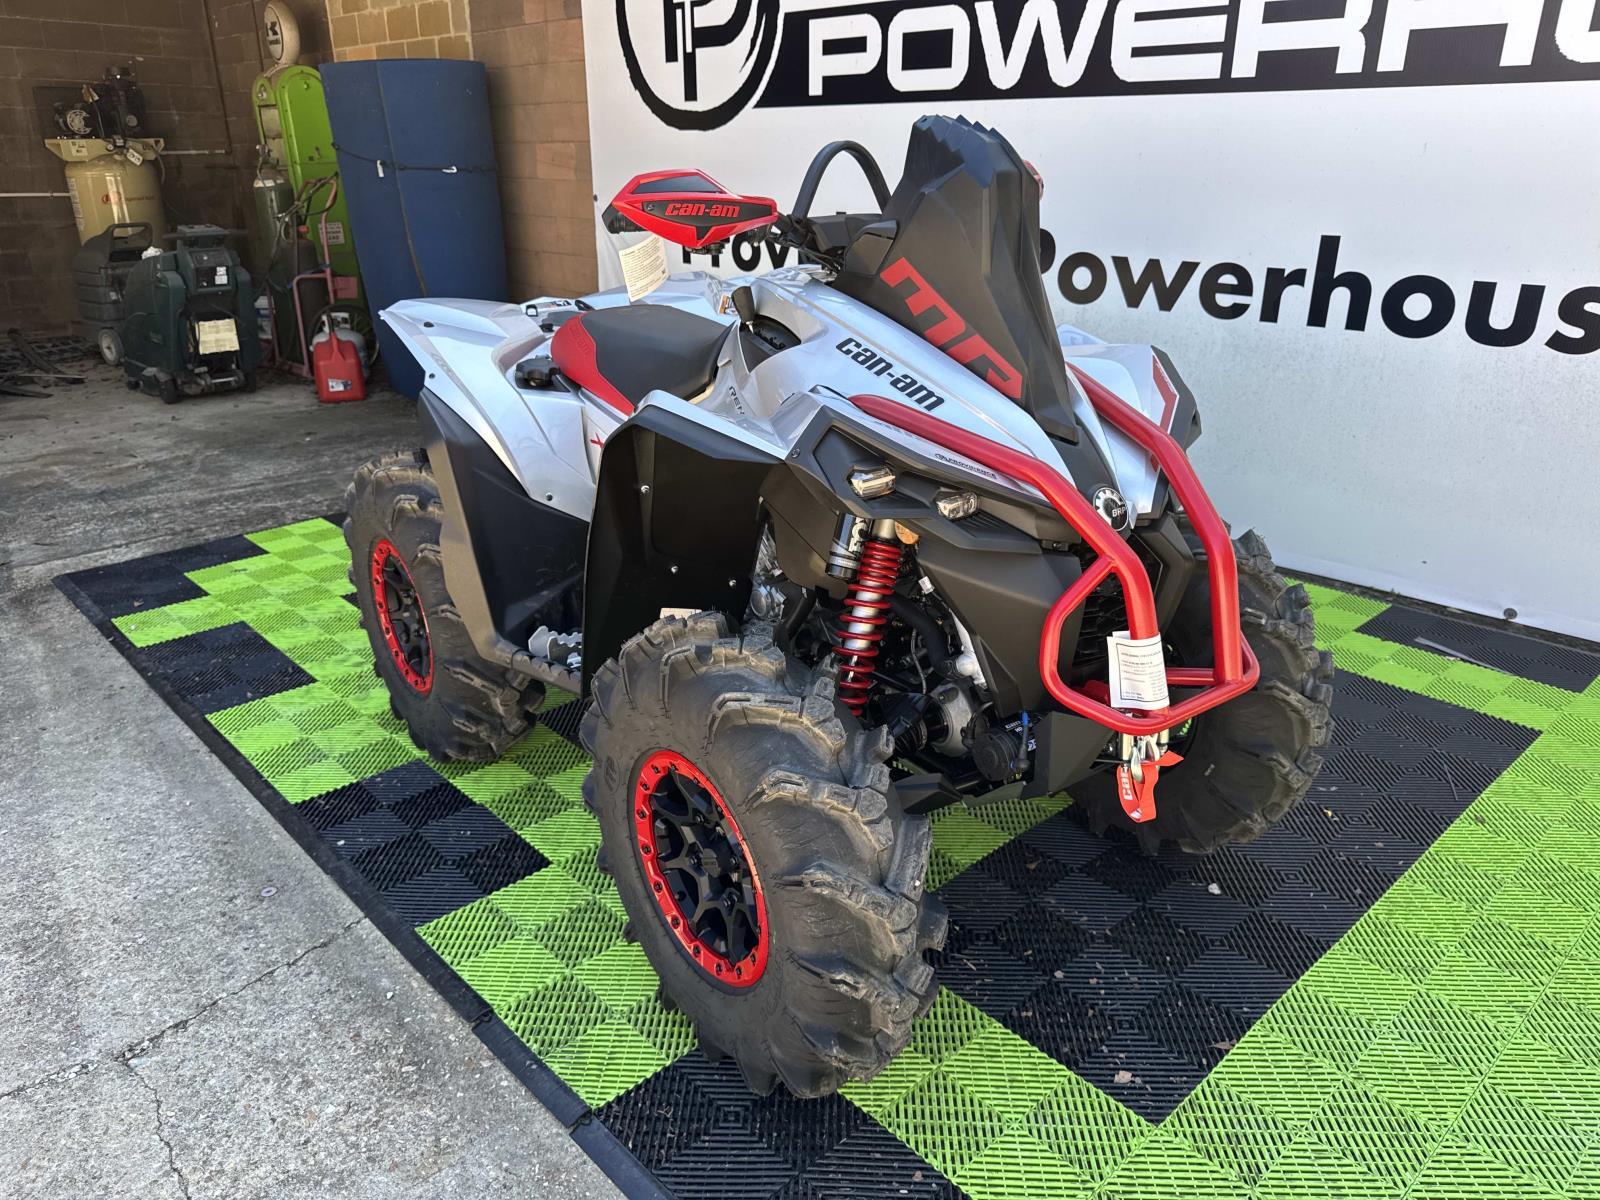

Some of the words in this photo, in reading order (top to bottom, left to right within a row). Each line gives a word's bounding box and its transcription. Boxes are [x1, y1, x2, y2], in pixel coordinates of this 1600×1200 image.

[664, 203, 741, 218] can-am
[836, 337, 945, 412] can-am
[1111, 506, 1126, 518] BRP
